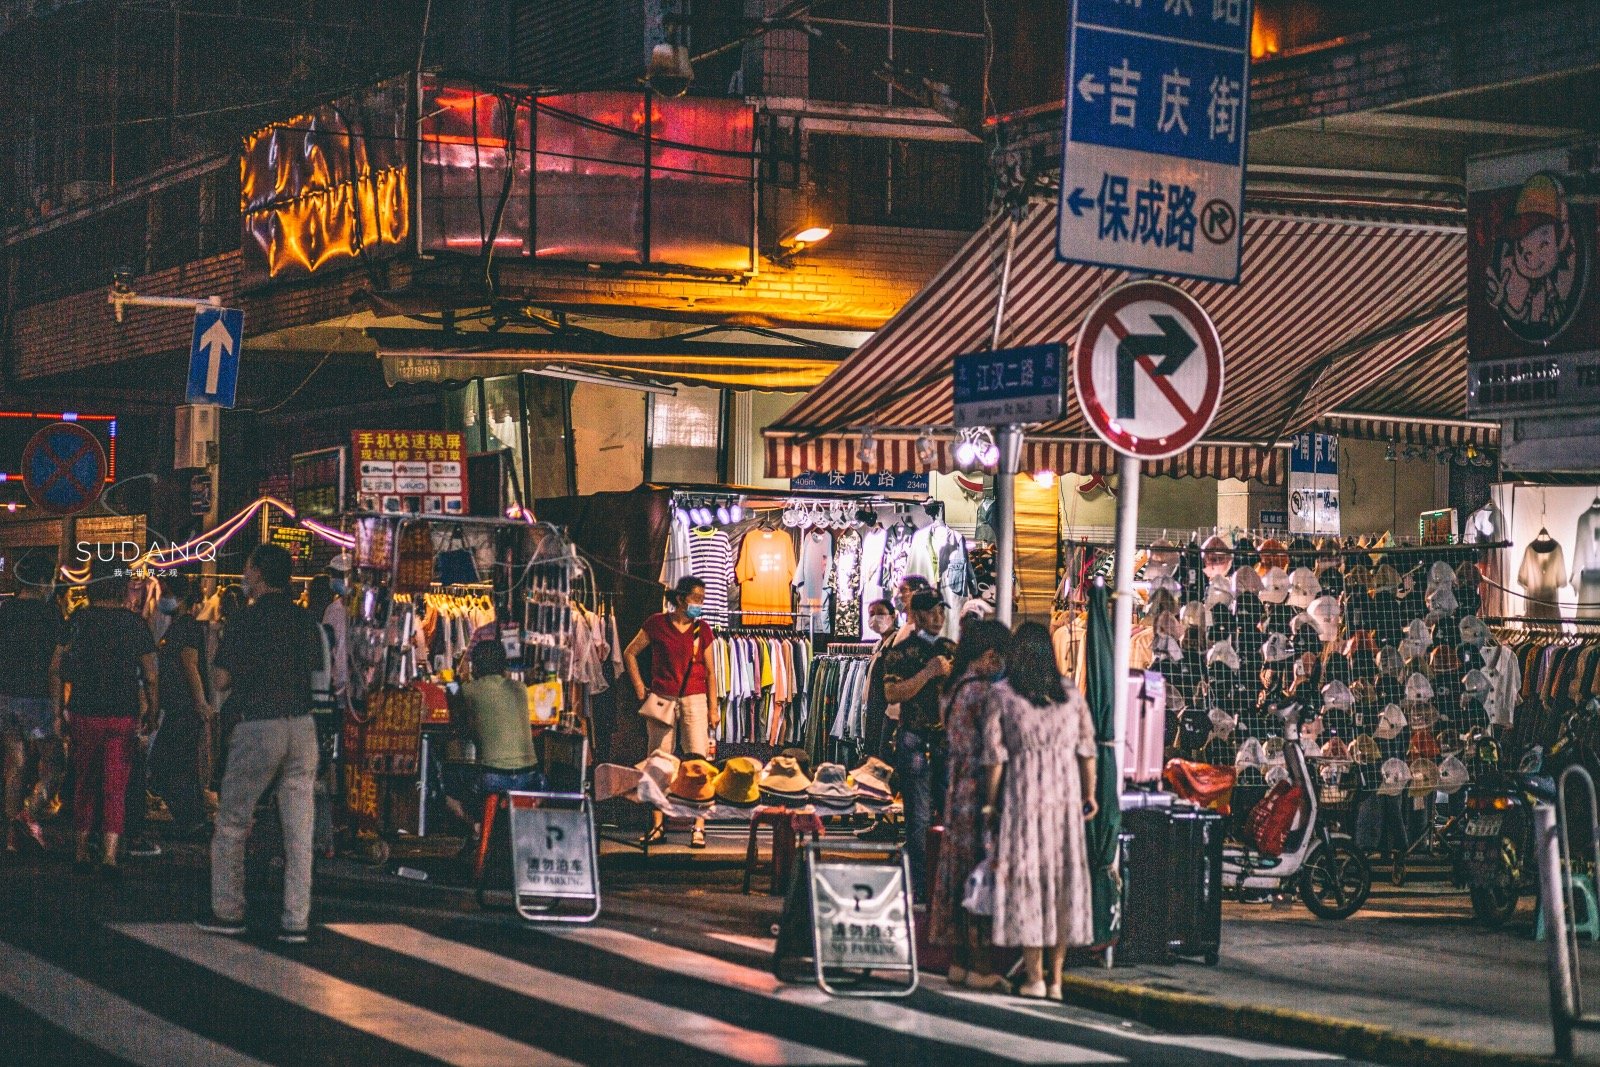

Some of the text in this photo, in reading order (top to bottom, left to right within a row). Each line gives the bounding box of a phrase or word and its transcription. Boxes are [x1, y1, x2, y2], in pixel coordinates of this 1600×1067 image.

[1108, 57, 1240, 143] 吉庆街
[1096, 172, 1198, 252] 保成路
[976, 358, 1034, 391] 江汉二路
[359, 433, 461, 448] 手机快速换屏
[827, 470, 896, 487] 保成路
[906, 481, 927, 489] 234m
